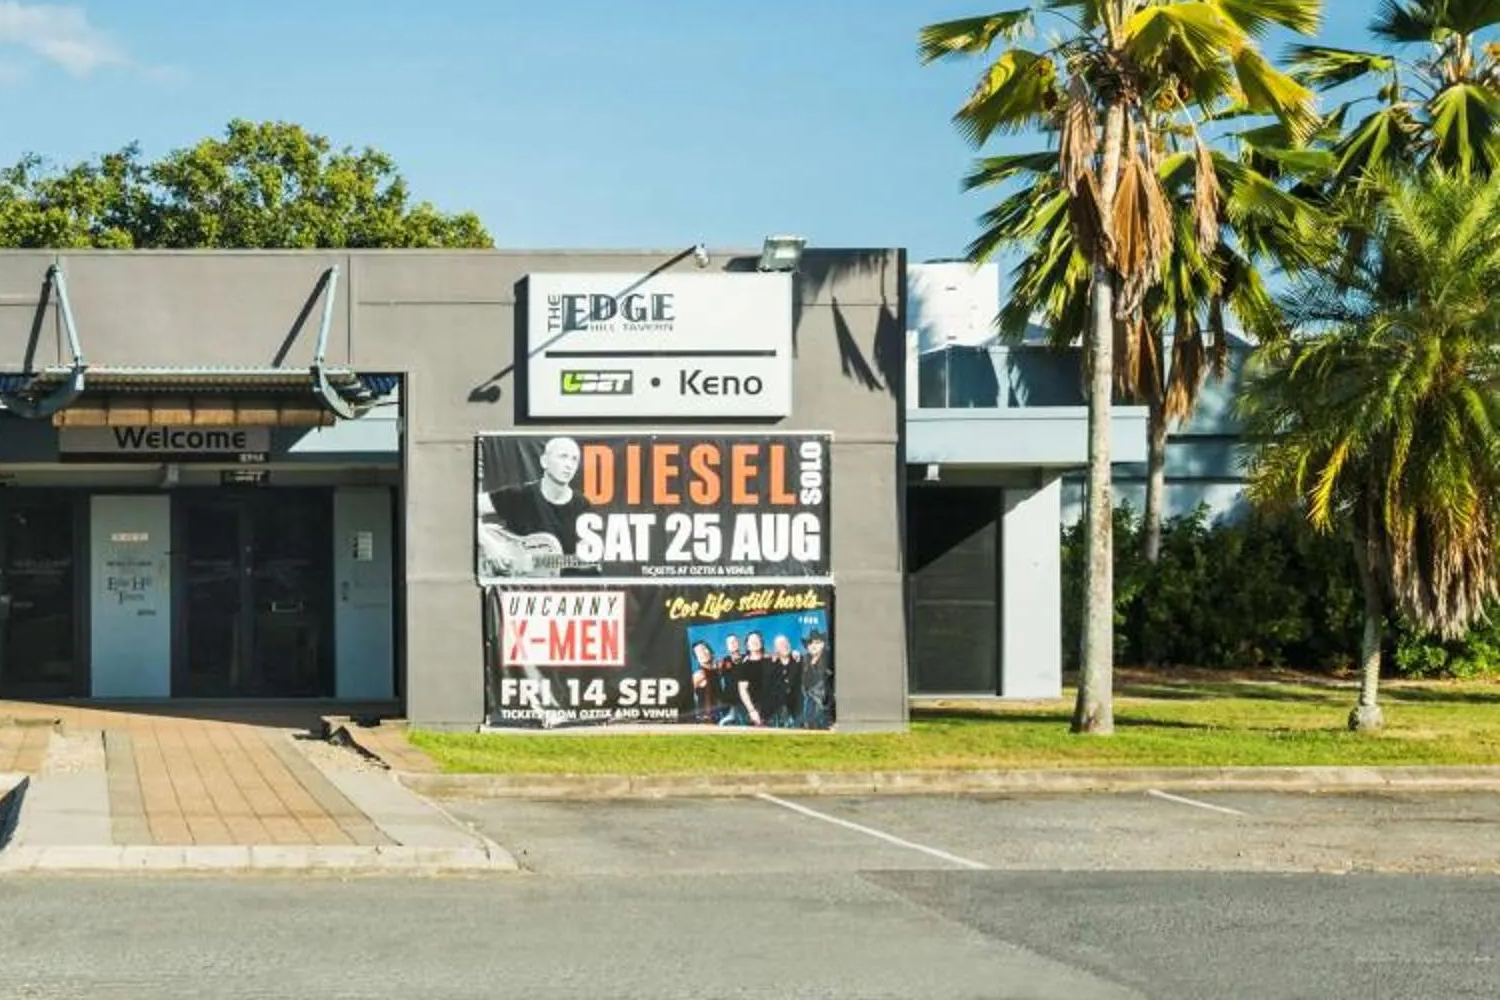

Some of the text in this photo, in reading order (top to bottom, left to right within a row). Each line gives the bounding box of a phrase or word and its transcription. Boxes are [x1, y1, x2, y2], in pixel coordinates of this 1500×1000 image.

[548, 294, 560, 332] THE
[562, 294, 675, 331] EDGE
[679, 369, 763, 396] Keno
[113, 425, 246, 449] Welcome
[583, 444, 797, 505] DIESEL
[800, 441, 823, 506] SOLO
[576, 513, 821, 562] SAT 25 AUG
[642, 565, 676, 576] TICKETS
[678, 565, 688, 575] AT
[726, 565, 755, 575] VENUE
[509, 596, 617, 616] UNCANNY
[700, 592, 734, 619] Life
[738, 589, 774, 611] still
[509, 619, 618, 660] X-MEN
[501, 678, 680, 706] FRI 14 SEP
[615, 708, 640, 719] AND
[643, 708, 679, 719] VENUE
